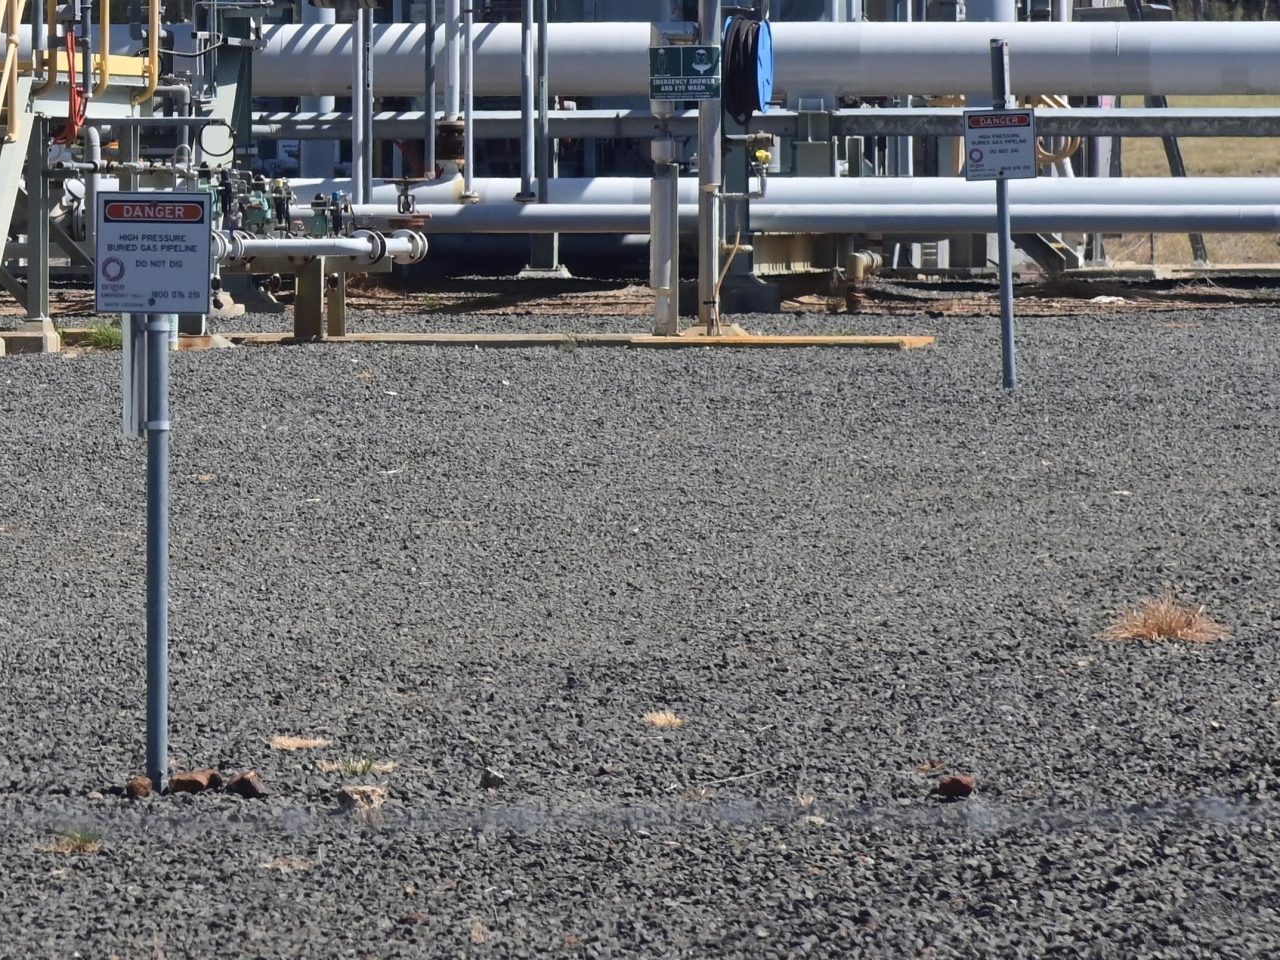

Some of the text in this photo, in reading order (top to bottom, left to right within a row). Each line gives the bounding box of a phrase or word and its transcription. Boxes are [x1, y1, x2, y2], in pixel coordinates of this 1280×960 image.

[980, 117, 1018, 125] DANGER
[122, 206, 184, 218] DANGER
[119, 234, 187, 242] HIGH PRESSURE
[107, 244, 198, 253] BURIED GAS PIPELINE
[135, 260, 183, 268] DO NOT DIG
[151, 291, 169, 299] 1800
